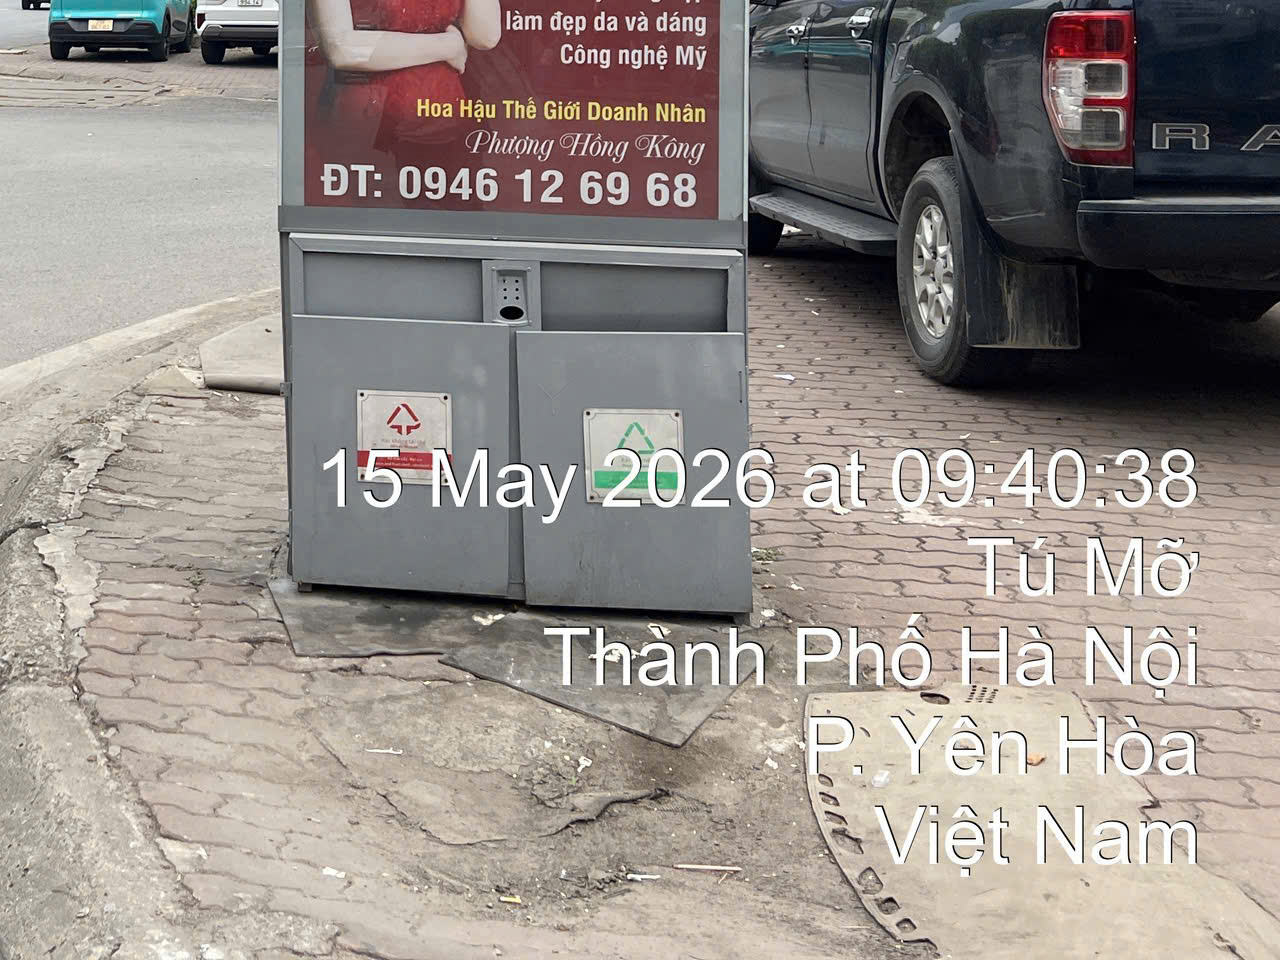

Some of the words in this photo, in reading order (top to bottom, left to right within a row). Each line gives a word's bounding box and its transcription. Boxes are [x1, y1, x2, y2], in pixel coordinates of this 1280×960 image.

[506, 10, 543, 31] làm
[550, 10, 587, 36] đẹp
[593, 11, 618, 32] da
[625, 11, 649, 32] và
[656, 11, 707, 37] dáng
[560, 43, 611, 69] Công
[618, 44, 668, 70] nghệ
[675, 45, 707, 71] Mỹ
[417, 98, 453, 118] Hoa
[459, 99, 496, 123] Hậu
[502, 96, 537, 120] Thế
[543, 100, 581, 121] Giới
[587, 101, 649, 122] Doanh
[655, 102, 706, 123] Nhân
[465, 130, 555, 162] Phượng
[559, 133, 630, 164] Hồng
[634, 134, 706, 166] Kông
[320, 163, 382, 198] ĐT:
[399, 165, 499, 202] 0946
[514, 168, 564, 203] 12
[579, 170, 630, 206] 69
[646, 172, 697, 208] 68
